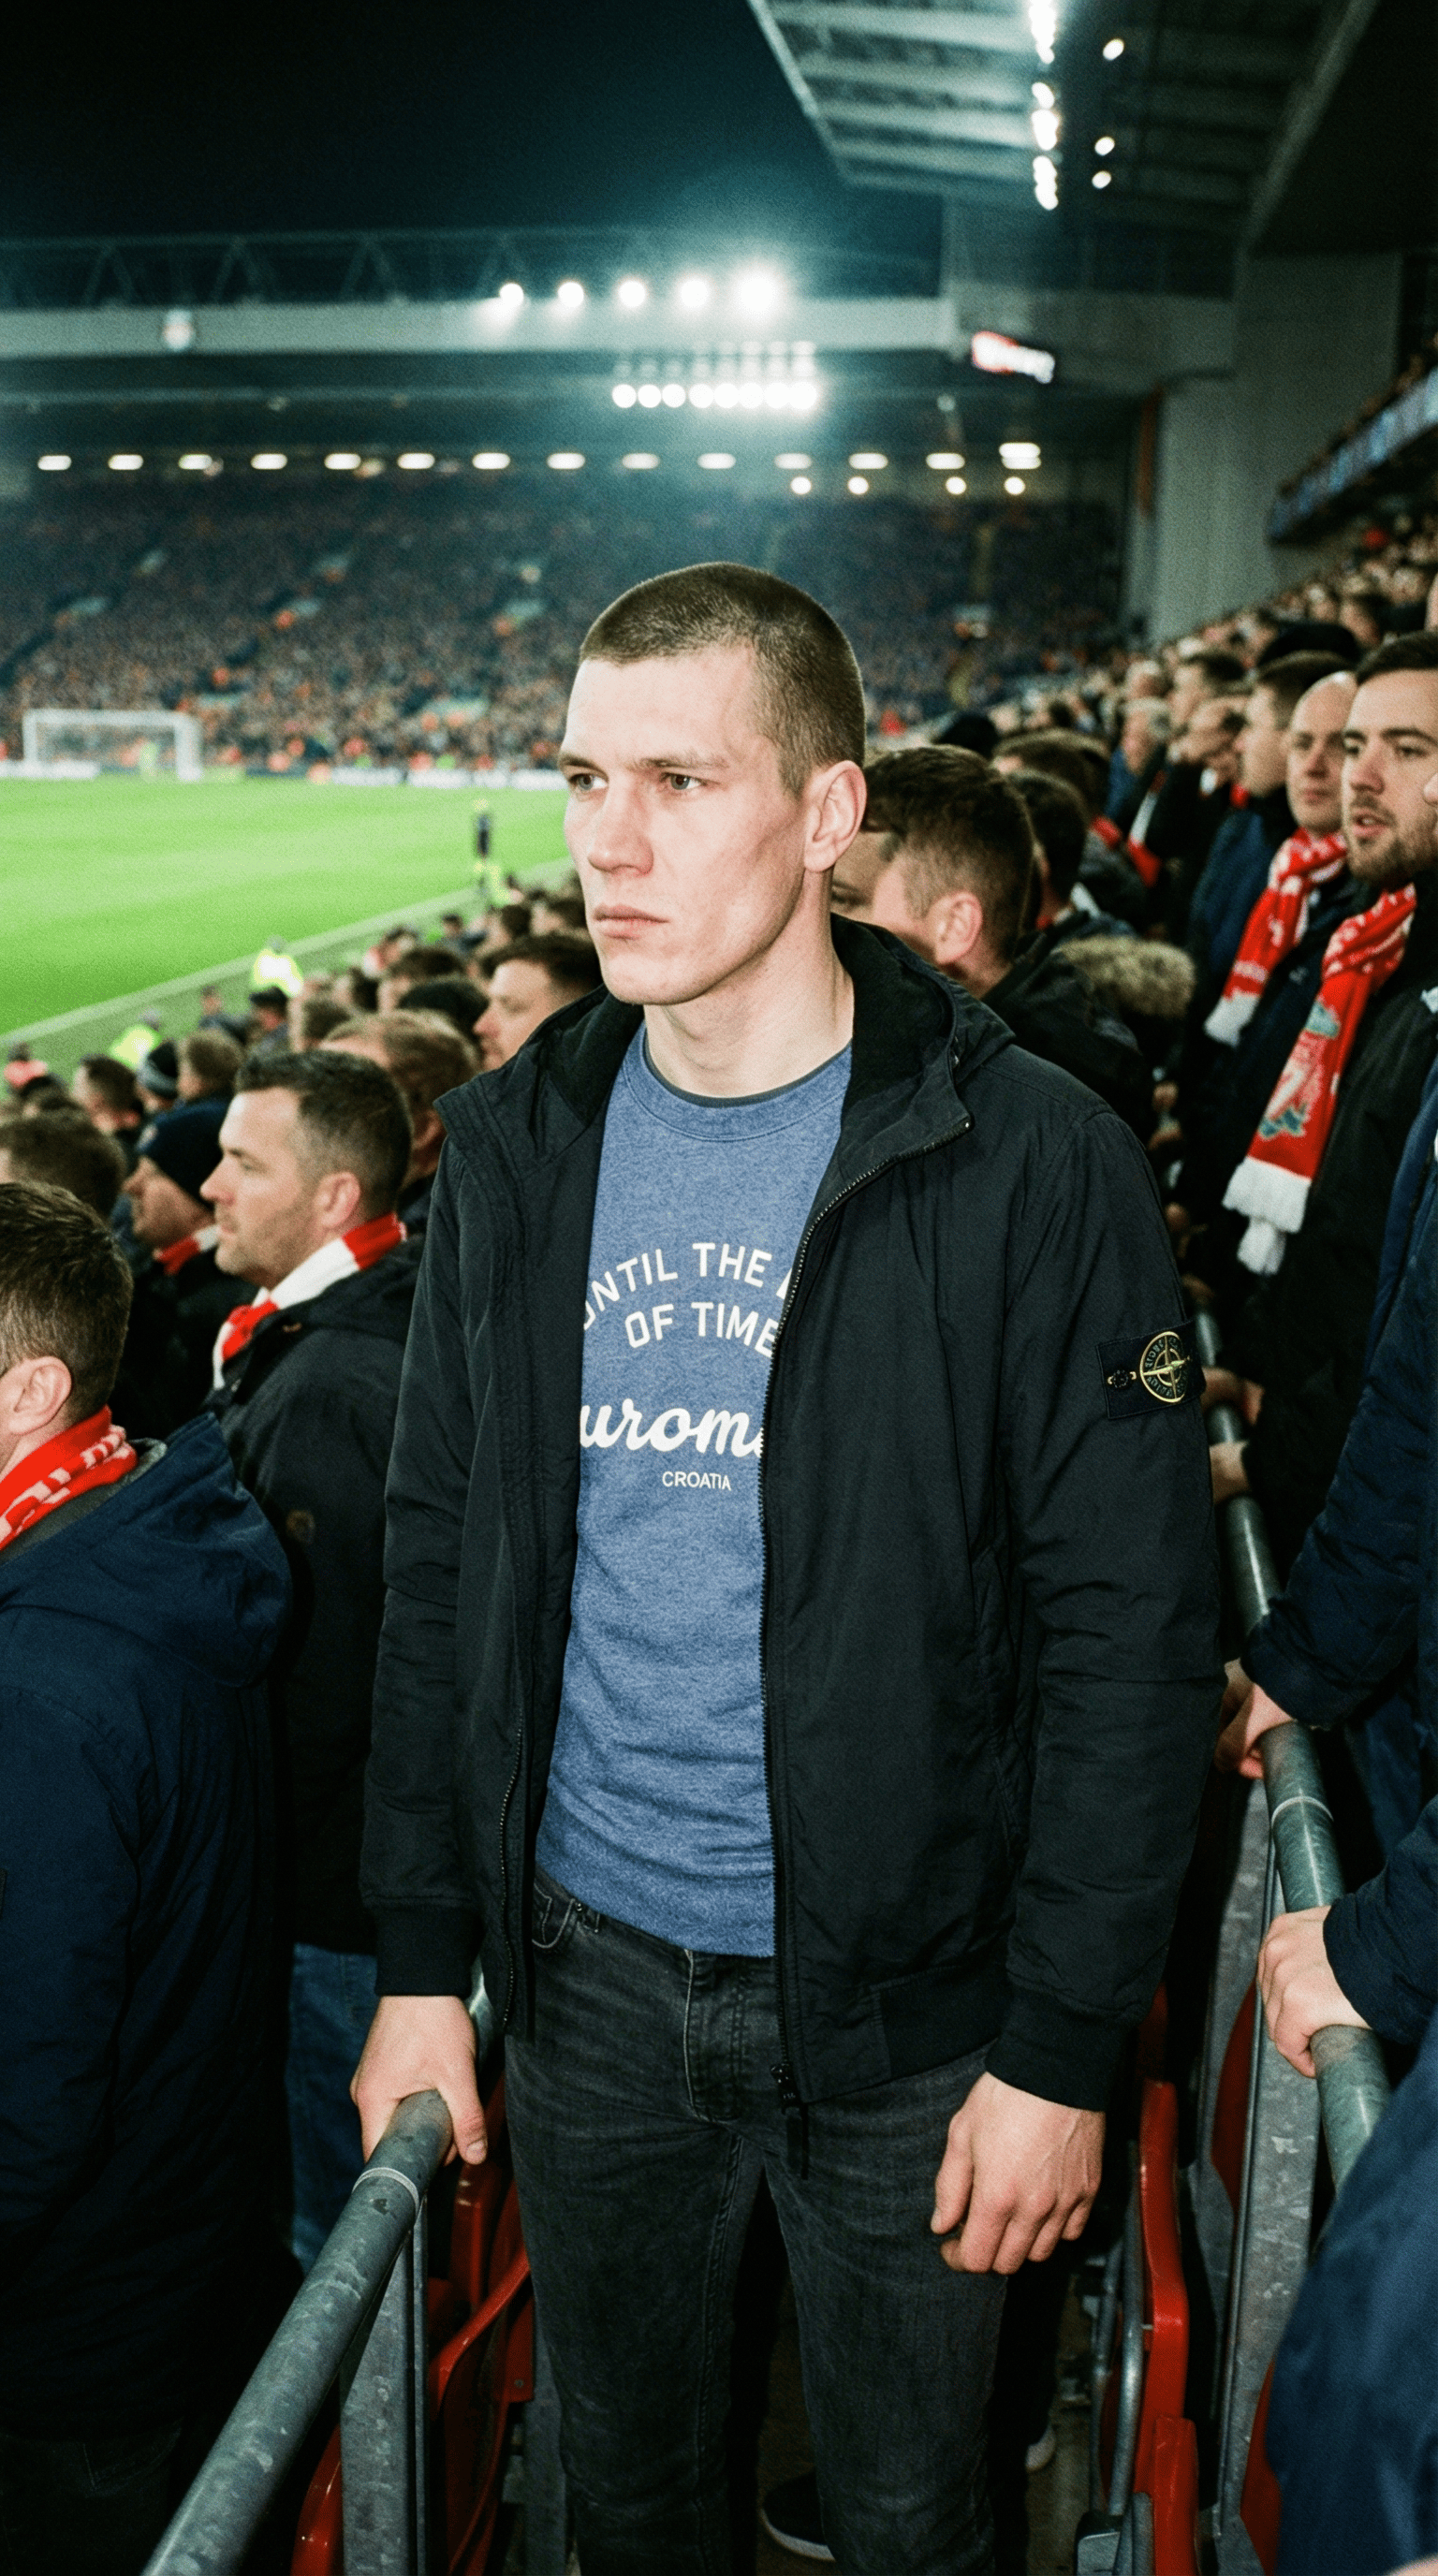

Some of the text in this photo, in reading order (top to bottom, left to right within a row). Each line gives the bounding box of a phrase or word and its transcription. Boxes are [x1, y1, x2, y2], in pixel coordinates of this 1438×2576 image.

[692, 1242, 773, 1288] THE
[624, 1301, 779, 1358] OF TIME
[661, 1471, 733, 1491] CROATIA
